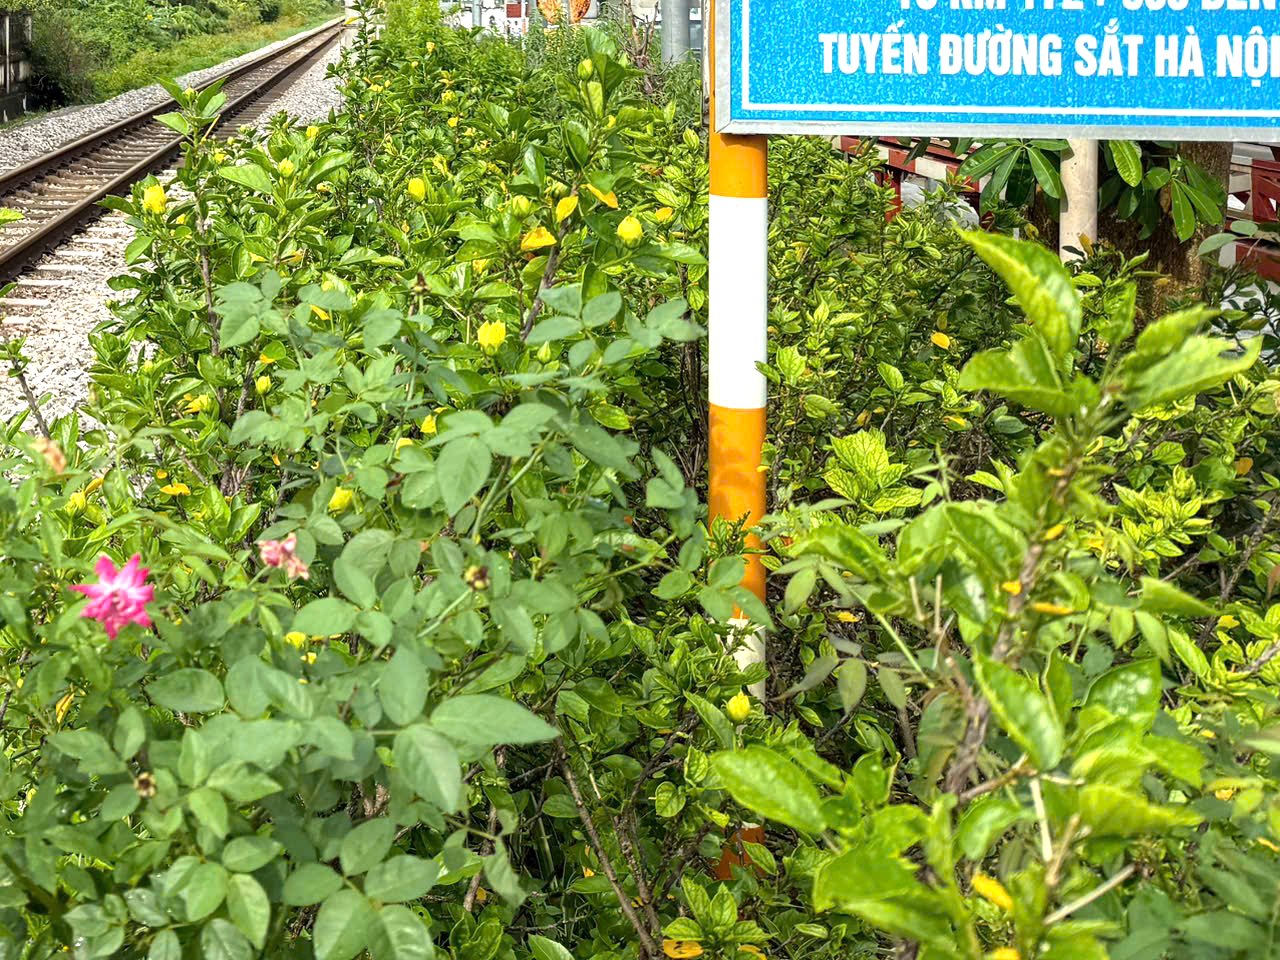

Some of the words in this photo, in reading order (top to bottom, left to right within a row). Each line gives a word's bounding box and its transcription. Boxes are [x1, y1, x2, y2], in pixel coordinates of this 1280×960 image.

[819, 19, 929, 75] TUYẾN
[939, 24, 1062, 76] ĐƯỜNG
[1074, 18, 1144, 77] SẮT
[1154, 26, 1205, 77] HÀ
[1216, 26, 1280, 88] NỘI
